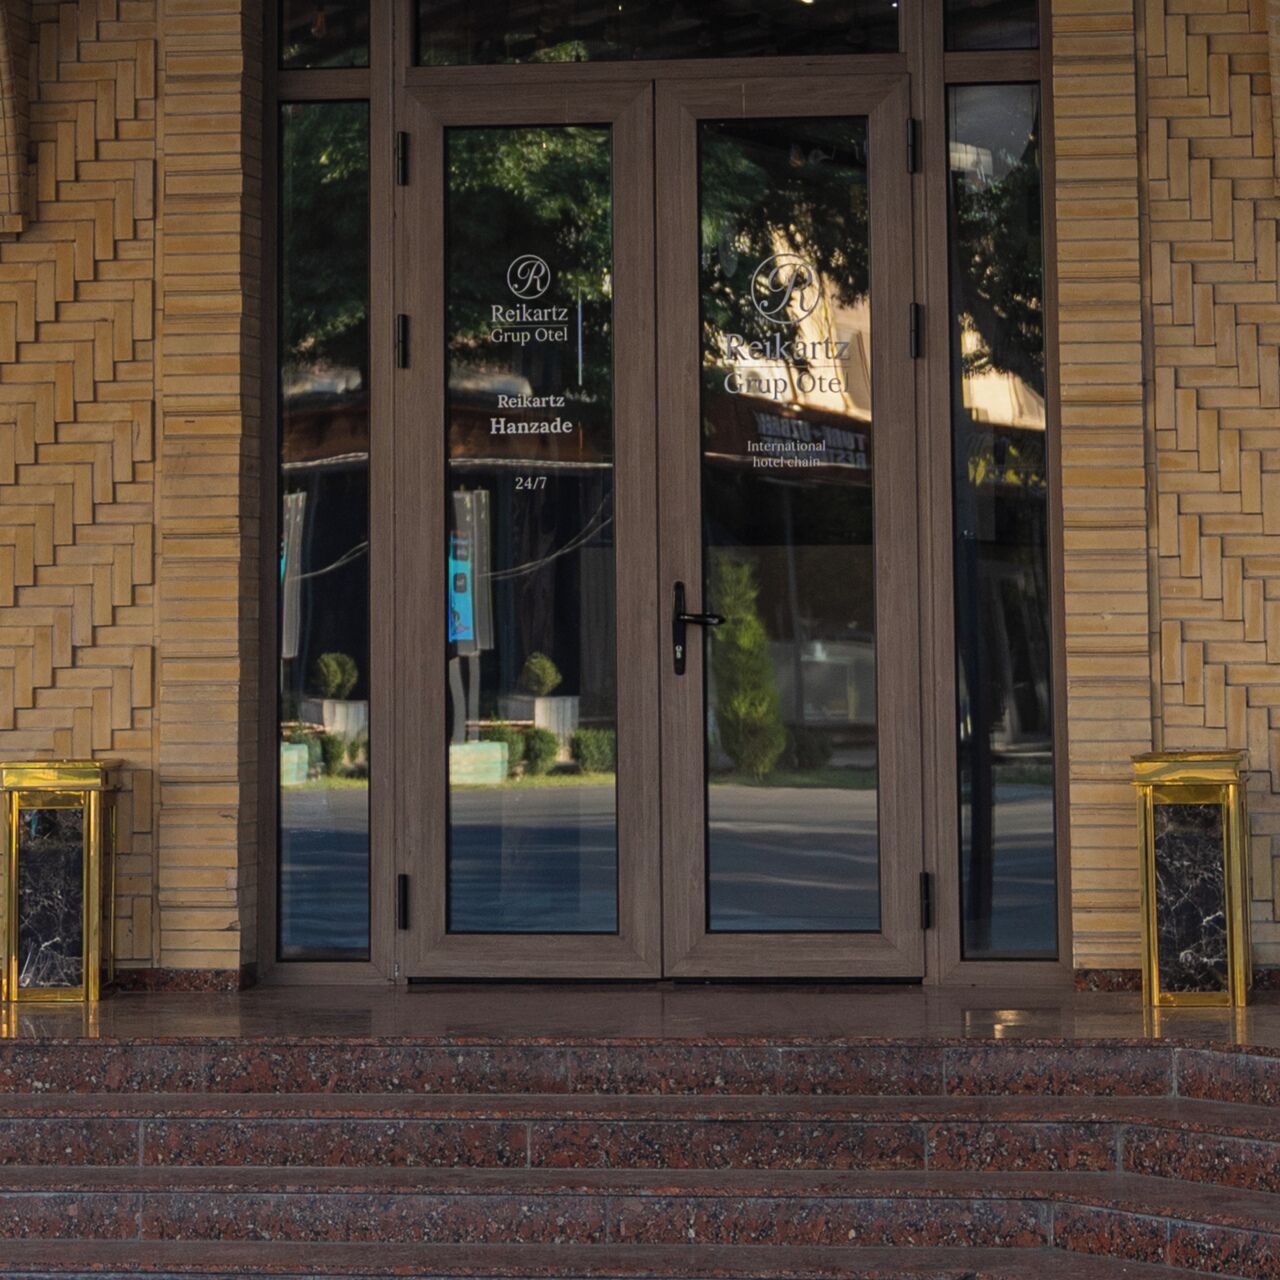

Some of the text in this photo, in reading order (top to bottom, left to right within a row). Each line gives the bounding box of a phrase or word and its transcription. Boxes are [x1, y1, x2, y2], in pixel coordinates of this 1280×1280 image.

[491, 304, 568, 322] Reikartz
[491, 327, 568, 347] Grup Otel
[724, 333, 851, 361] Reikartz
[724, 372, 849, 401] Grup Otel
[497, 394, 565, 408] Reikartz
[490, 418, 573, 434] Hanzade
[747, 439, 826, 452] International
[753, 456, 784, 468] hotel
[787, 456, 821, 468] chain
[515, 477, 548, 490] 24/7
